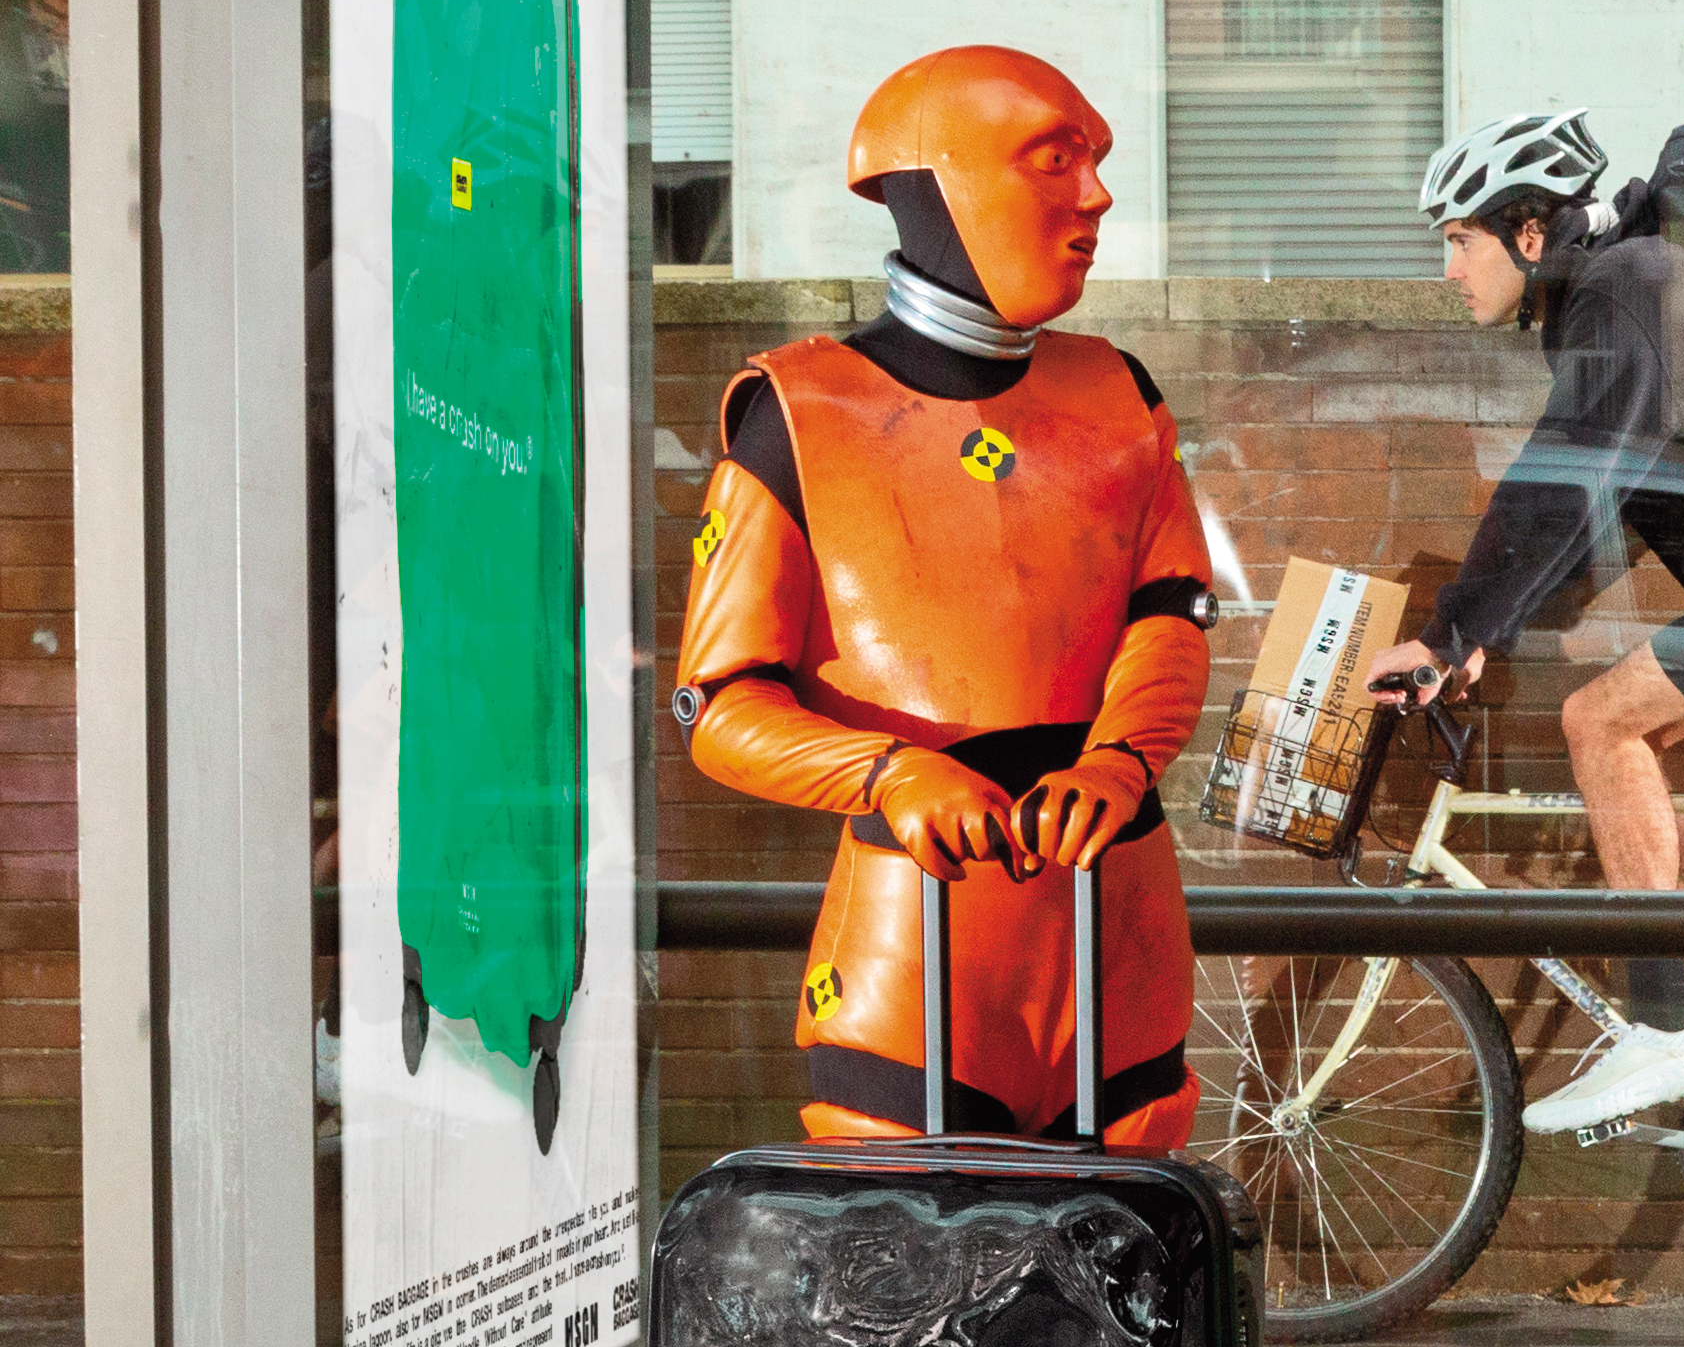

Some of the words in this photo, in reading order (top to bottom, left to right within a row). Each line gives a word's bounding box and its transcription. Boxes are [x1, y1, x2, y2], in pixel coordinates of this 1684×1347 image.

[412, 372, 437, 425] have
[440, 399, 446, 431] a
[1353, 599, 1373, 627] ITEM
[1315, 616, 1341, 654] MSGM
[1292, 676, 1317, 717] MSGM
[370, 1295, 393, 1322] CRASH
[398, 1279, 428, 1309] BAGGAGE
[432, 1277, 438, 1293] in
[423, 1299, 443, 1325] MSGM
[471, 1303, 491, 1327] CRASH
